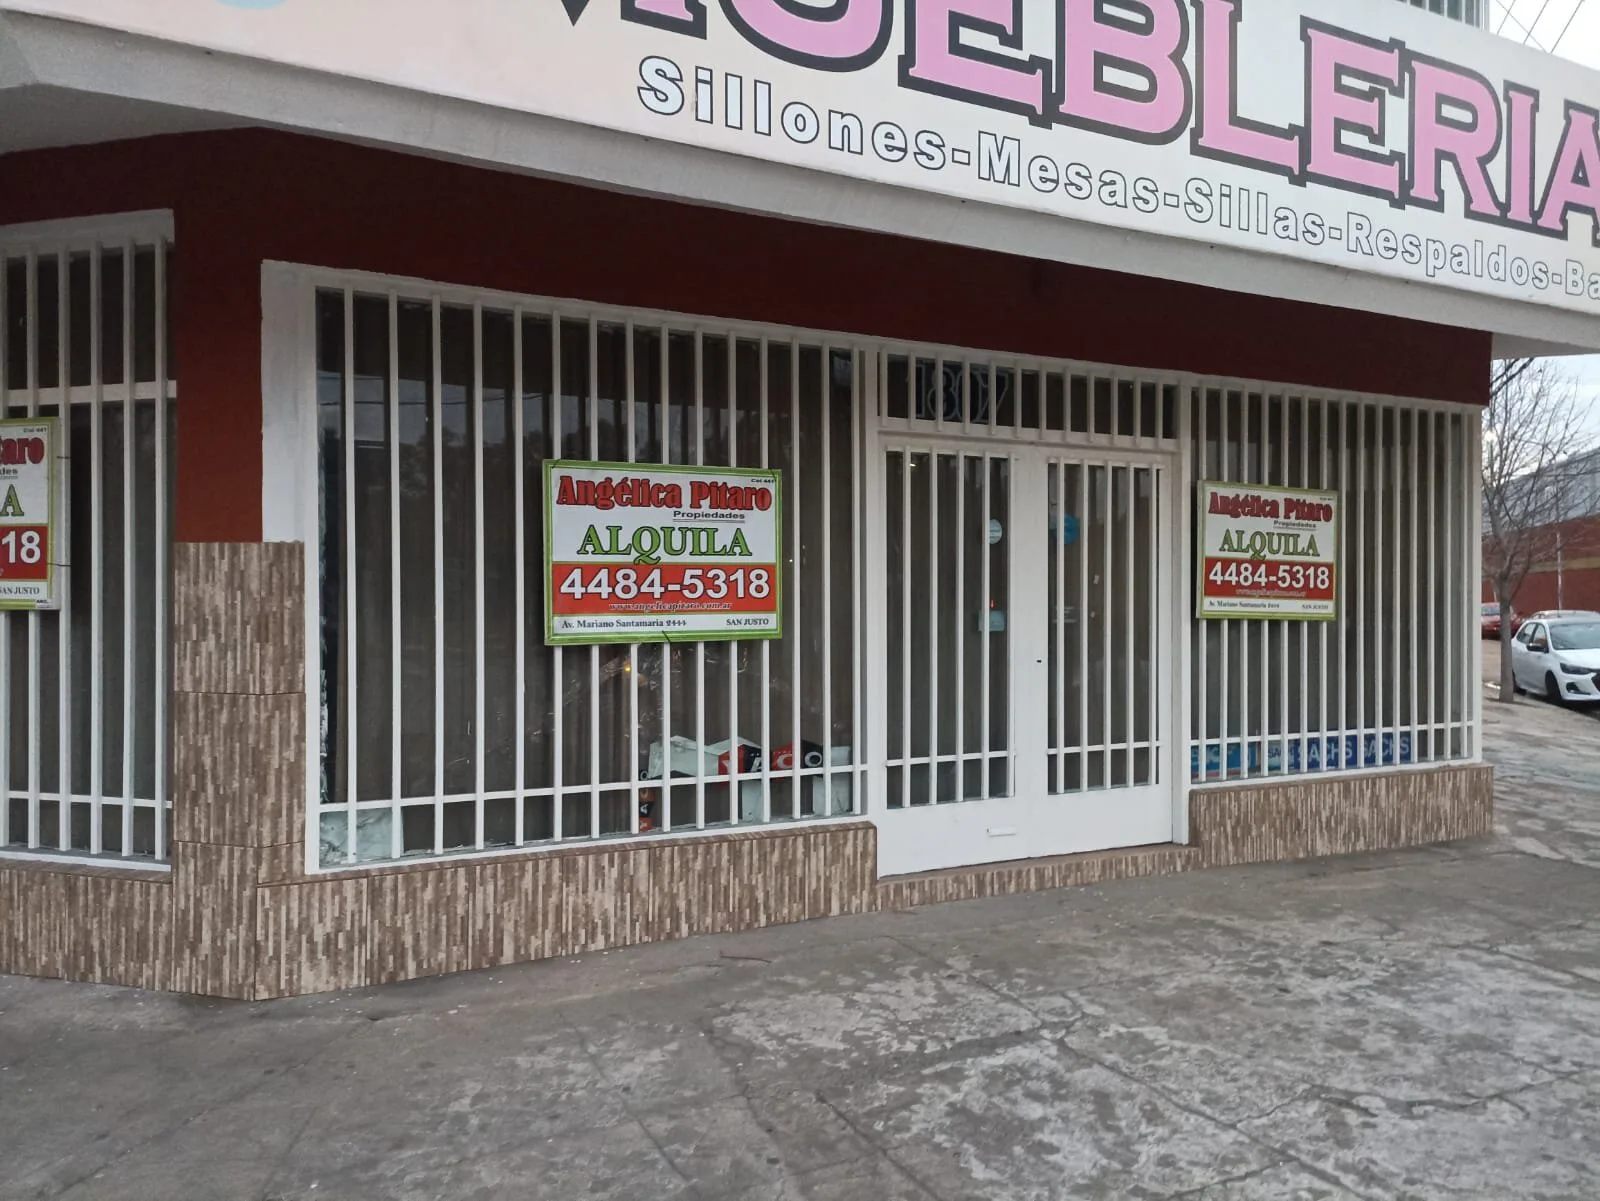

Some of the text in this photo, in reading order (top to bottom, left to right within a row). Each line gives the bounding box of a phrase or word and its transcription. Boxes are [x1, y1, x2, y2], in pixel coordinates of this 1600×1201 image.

[561, 0, 1600, 248] EBLERIA
[0, 436, 45, 465] aro
[556, 475, 772, 511] Angélica Pitaro
[1208, 491, 1333, 523] Angélica Pitaro
[673, 510, 745, 520] Propiedades
[576, 524, 752, 565] ALQUILA
[1218, 528, 1321, 560] ALQUILA
[559, 566, 771, 600] 4484-5318
[1208, 561, 1330, 590] 4484-5318
[561, 620, 575, 629] Av.
[577, 619, 614, 629] Mariano
[726, 617, 769, 626] SAN JUSTO
